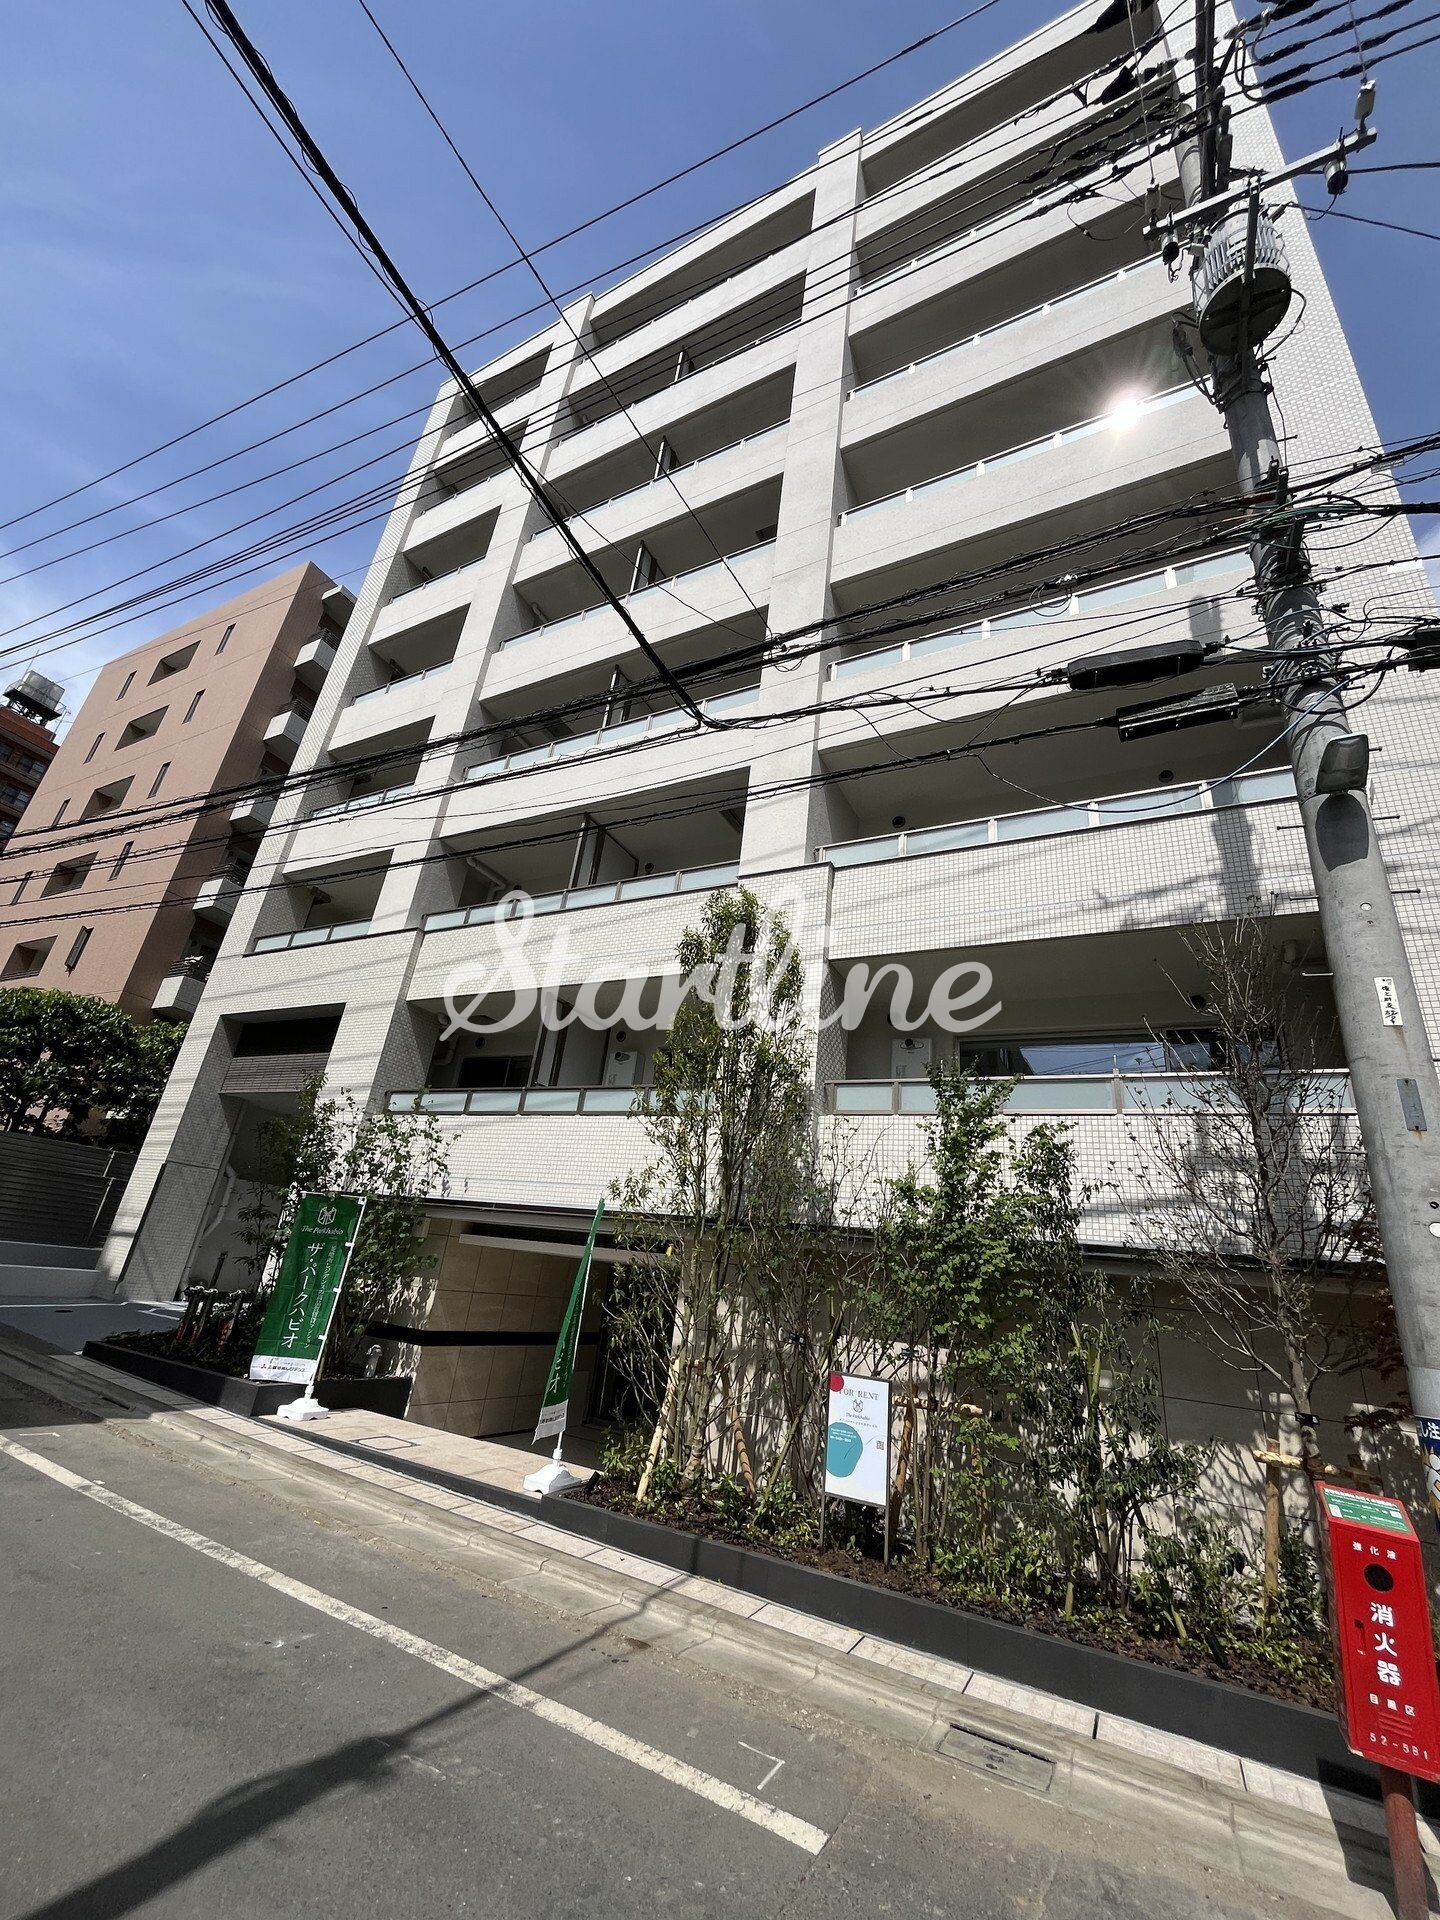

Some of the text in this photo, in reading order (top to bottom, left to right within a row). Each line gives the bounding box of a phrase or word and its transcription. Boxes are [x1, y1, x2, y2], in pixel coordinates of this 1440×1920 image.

[281, 1242, 325, 1349] ザ・パークハビオ
[858, 1390, 879, 1400] RENT
[1370, 1601, 1402, 1687] 消火器
